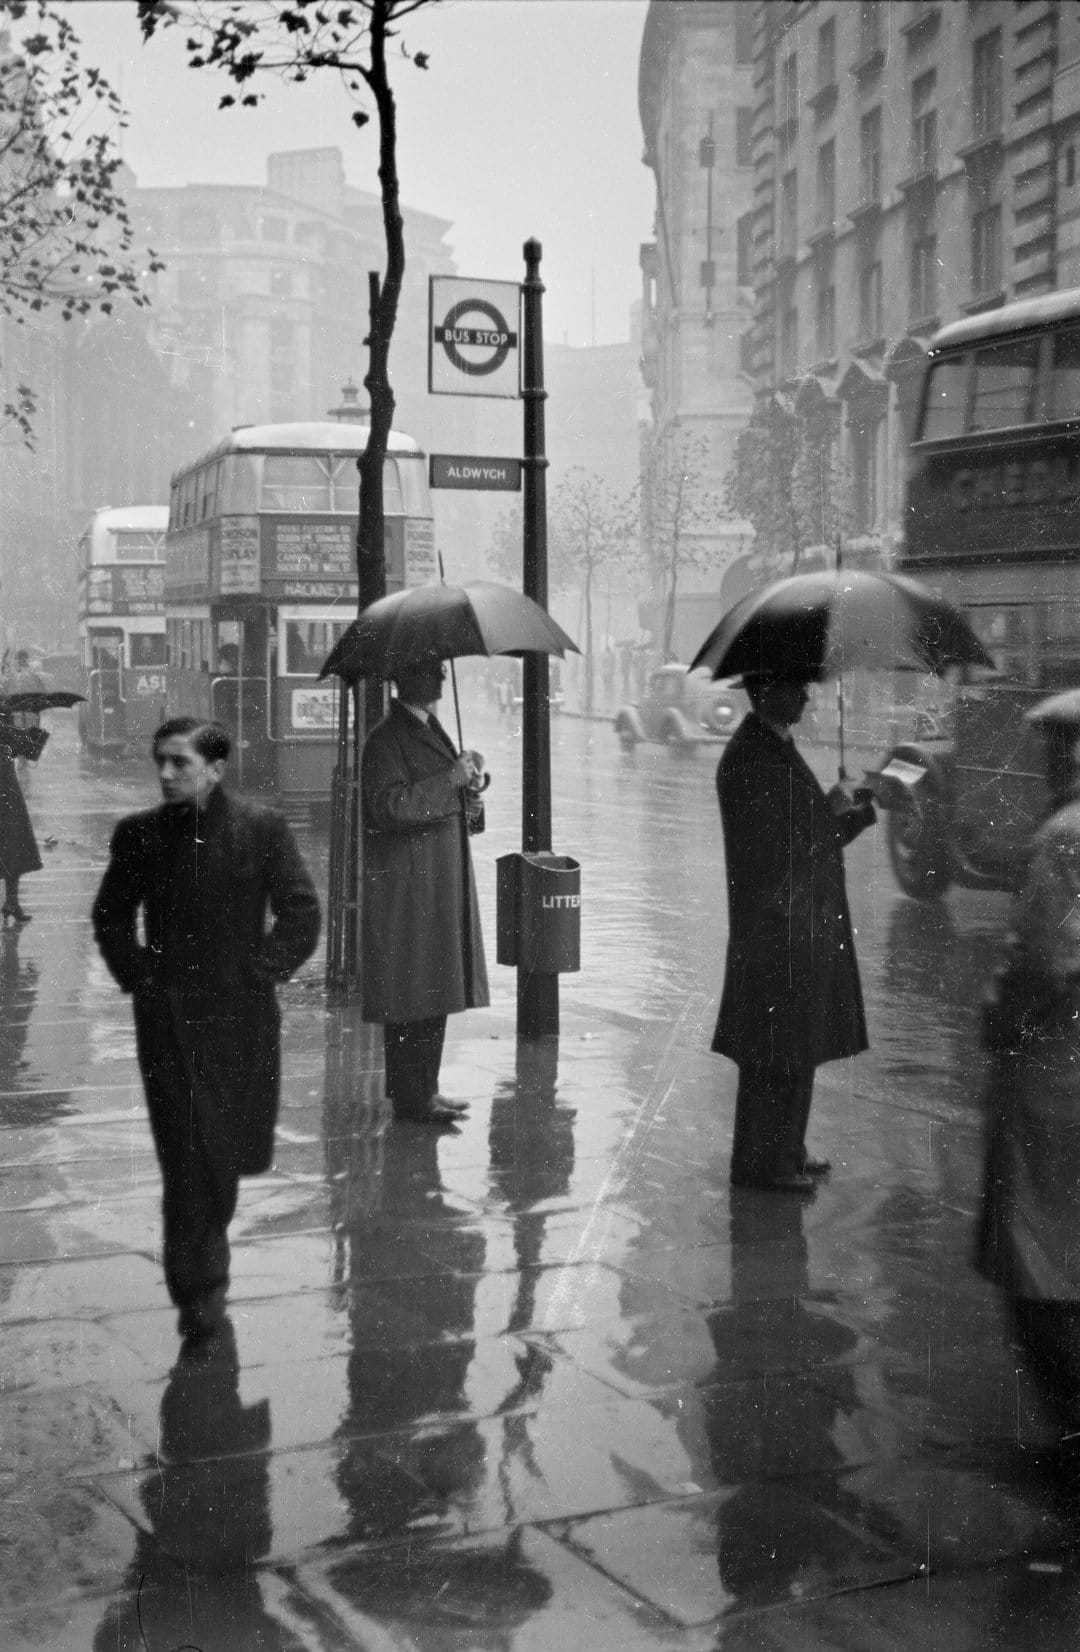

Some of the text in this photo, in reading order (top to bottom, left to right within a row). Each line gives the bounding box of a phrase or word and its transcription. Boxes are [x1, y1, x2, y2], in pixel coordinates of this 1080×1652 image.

[444, 329, 508, 345] BUS STOP
[447, 467, 506, 480] ALDWYCH
[284, 581, 344, 597] HACKNEY
